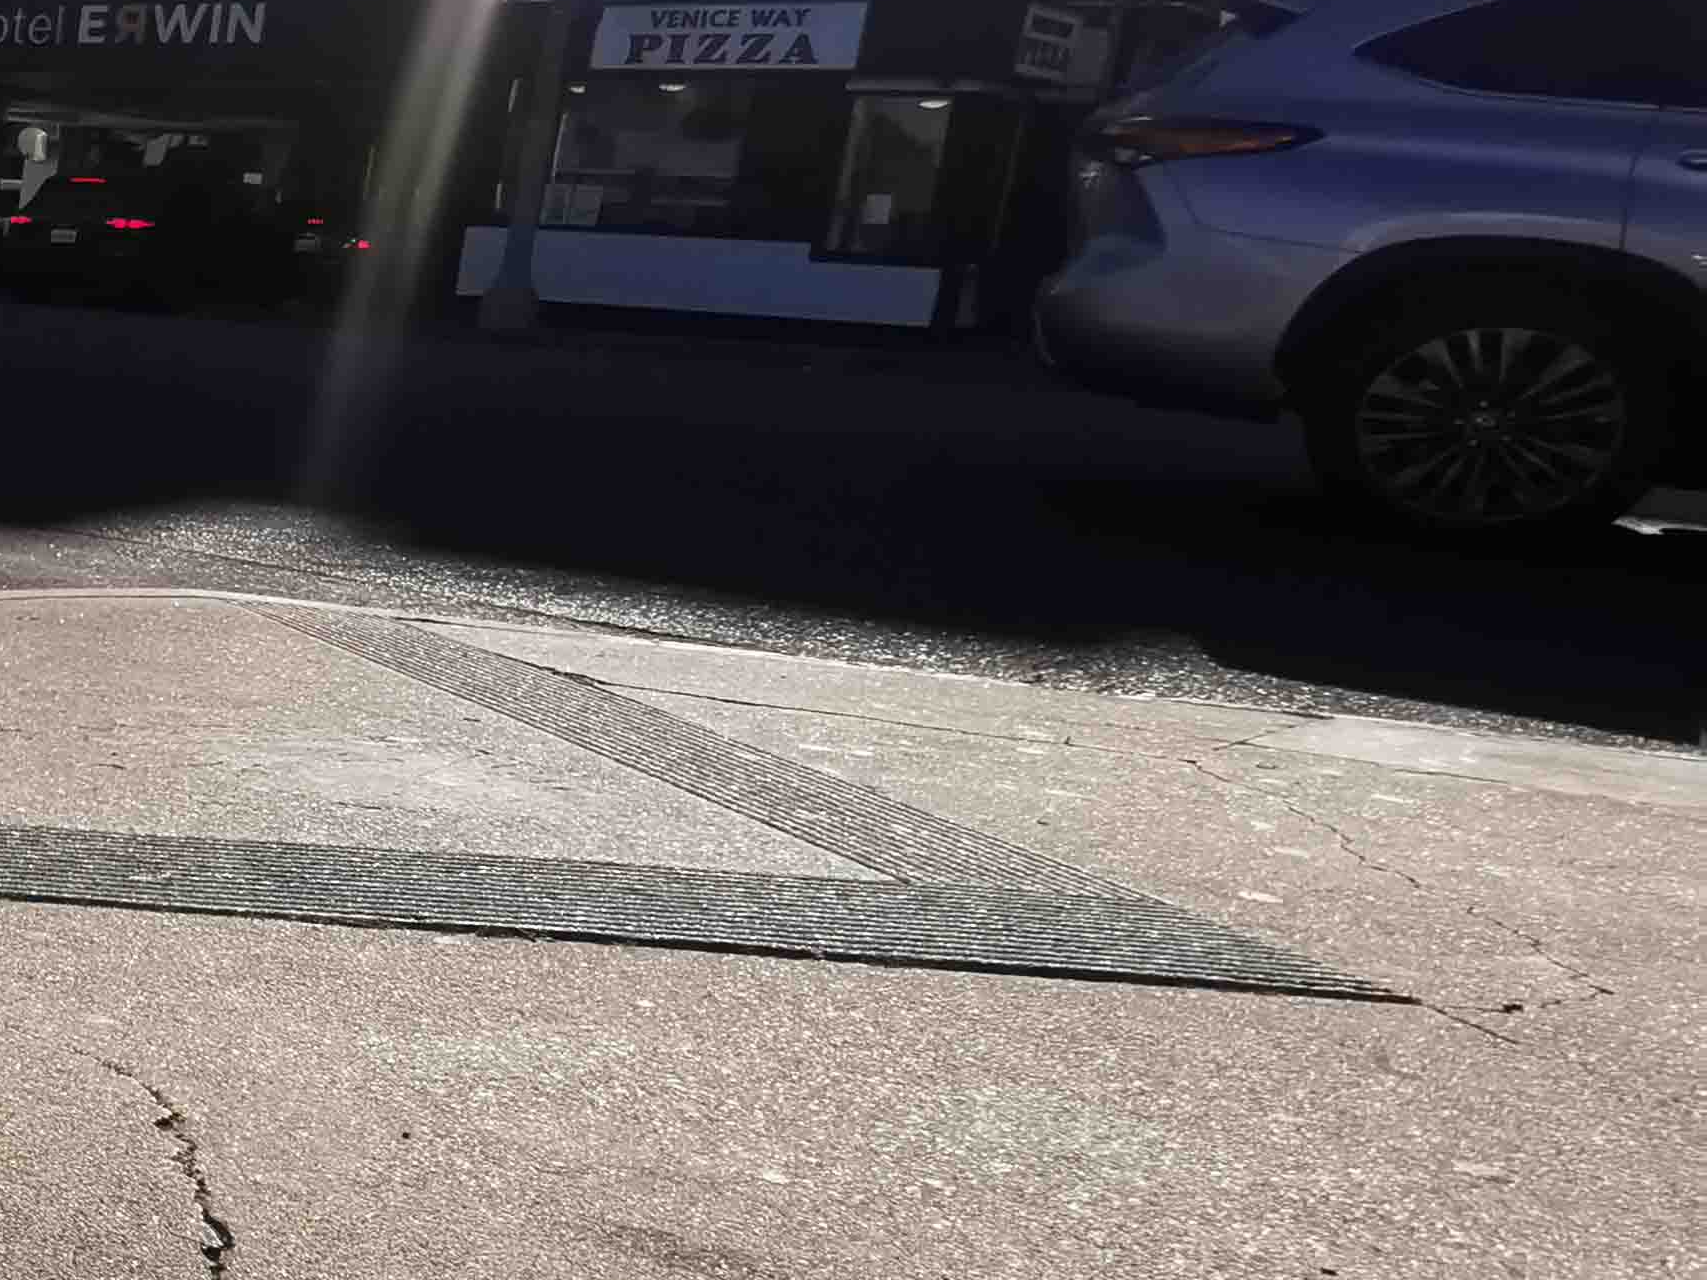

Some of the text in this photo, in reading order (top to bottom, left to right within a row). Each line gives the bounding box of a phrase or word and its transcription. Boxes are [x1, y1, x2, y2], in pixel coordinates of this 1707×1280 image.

[649, 7, 813, 29] VENICE WAY
[623, 31, 819, 66] PIZZA
